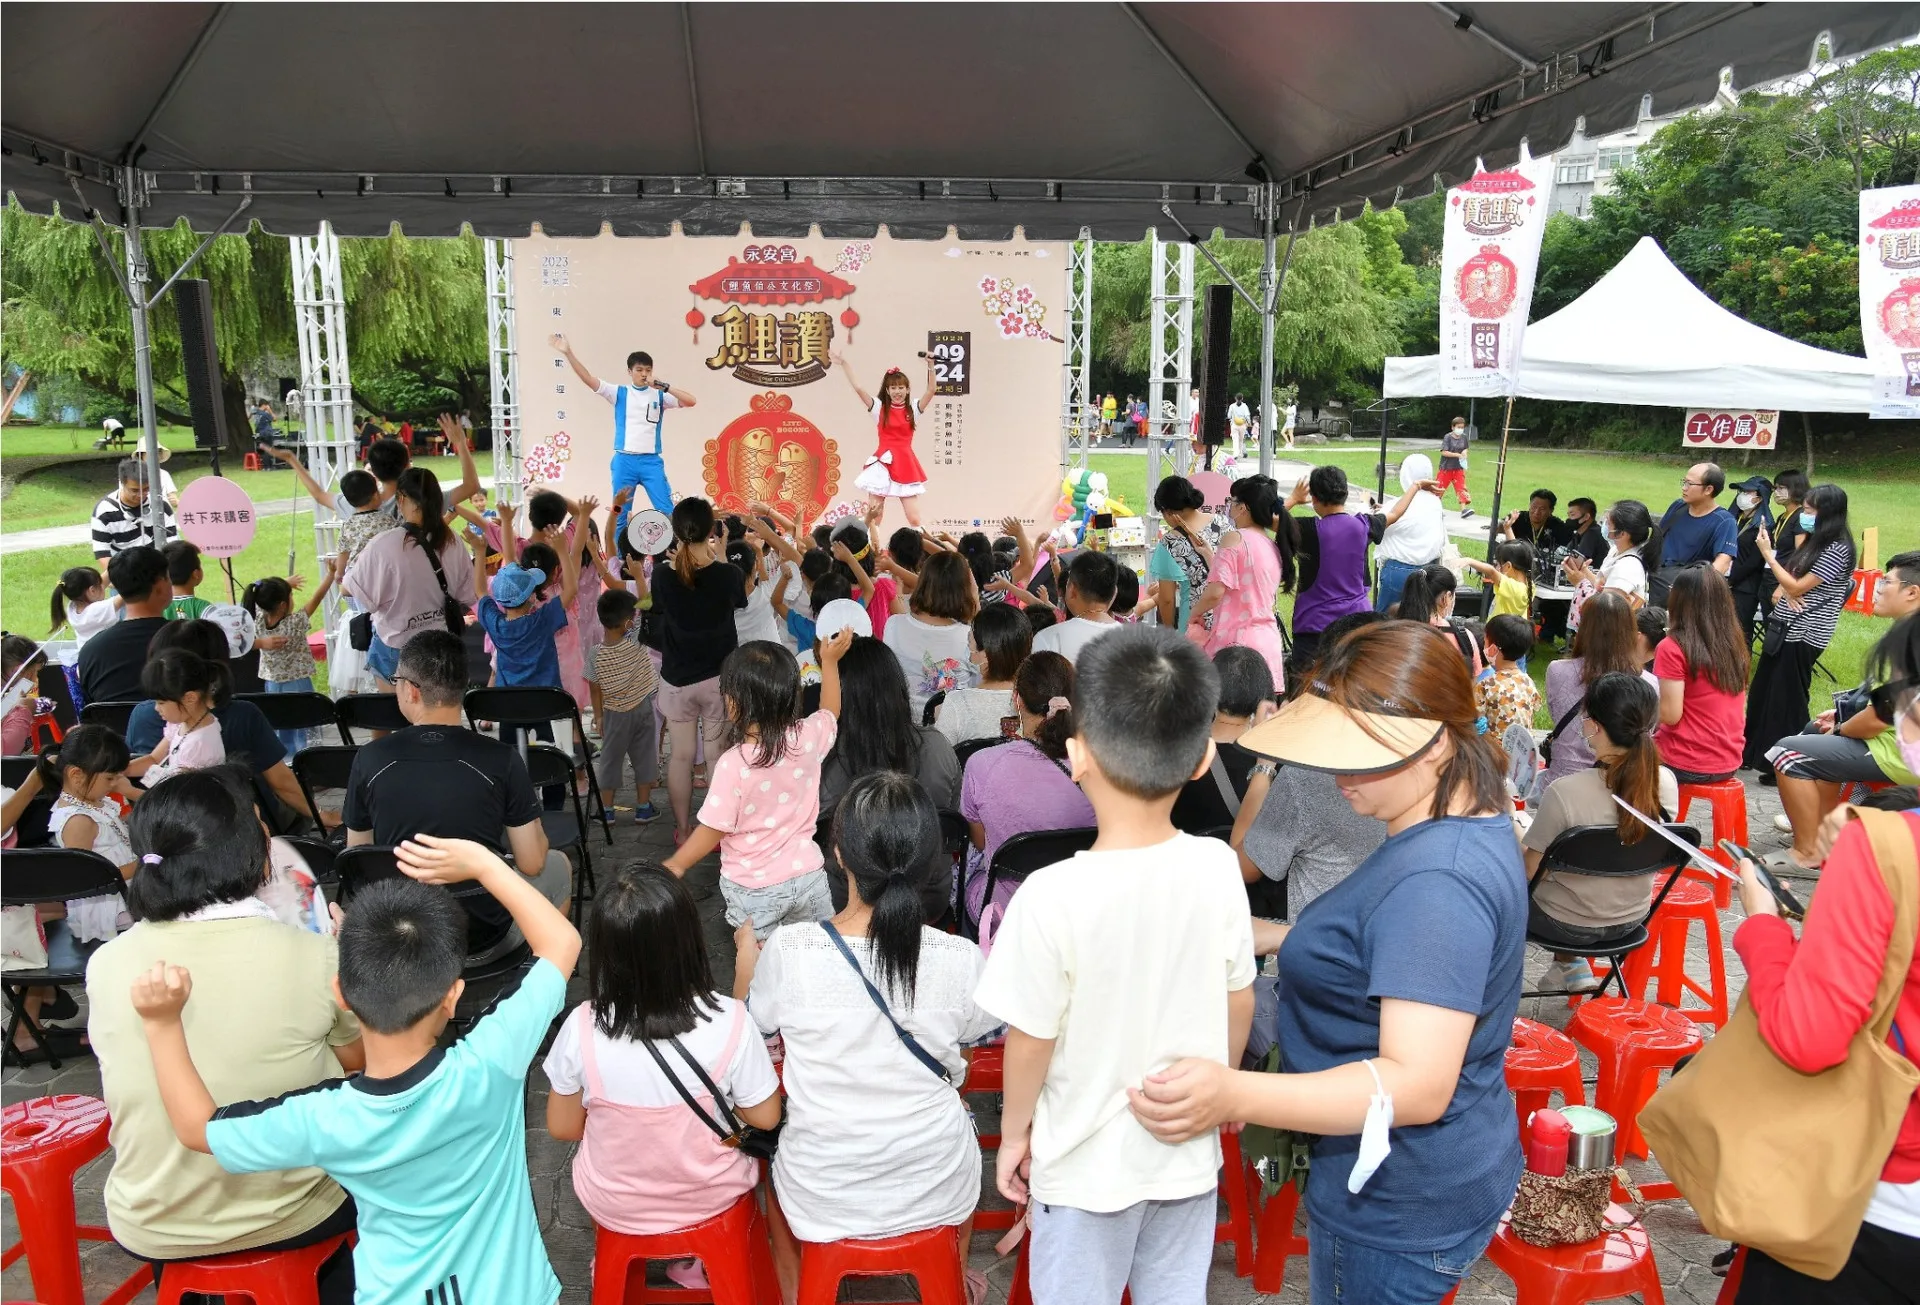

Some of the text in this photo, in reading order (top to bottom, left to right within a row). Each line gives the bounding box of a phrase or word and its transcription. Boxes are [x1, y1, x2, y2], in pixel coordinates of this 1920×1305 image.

[542, 256, 569, 267] 2023
[745, 248, 795, 262] 永安宮
[728, 280, 814, 292] 鯉魚伯公文化祭
[705, 304, 835, 370] 鯉讚
[933, 343, 965, 363] 09
[933, 363, 965, 382] 24
[1688, 418, 1754, 439] 工作區
[183, 510, 250, 525] 共下來講客
